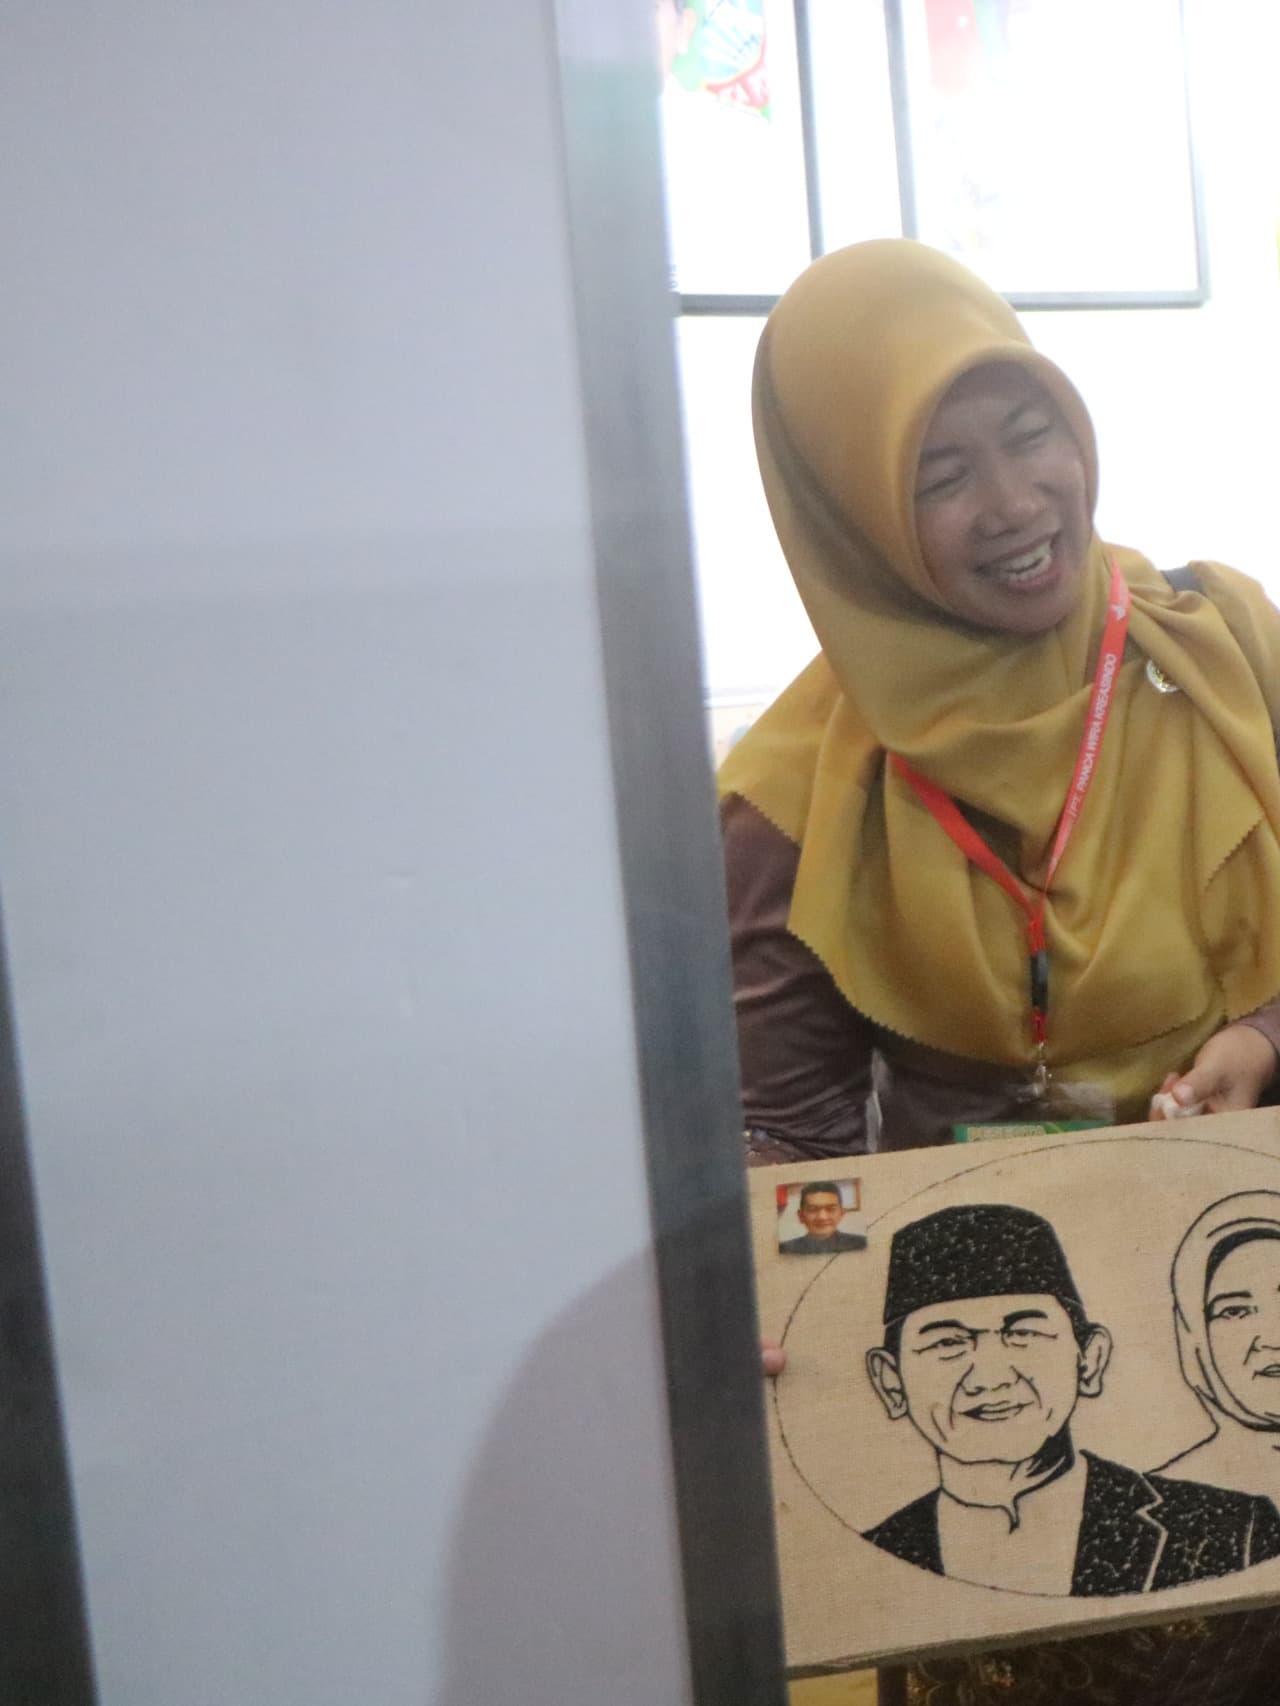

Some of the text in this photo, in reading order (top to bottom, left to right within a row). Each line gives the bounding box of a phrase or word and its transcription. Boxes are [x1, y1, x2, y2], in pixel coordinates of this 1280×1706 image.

[1077, 752, 1095, 793] PANCA
[1087, 720, 1103, 751] WIRA
[1095, 653, 1117, 720] KREASINDO
